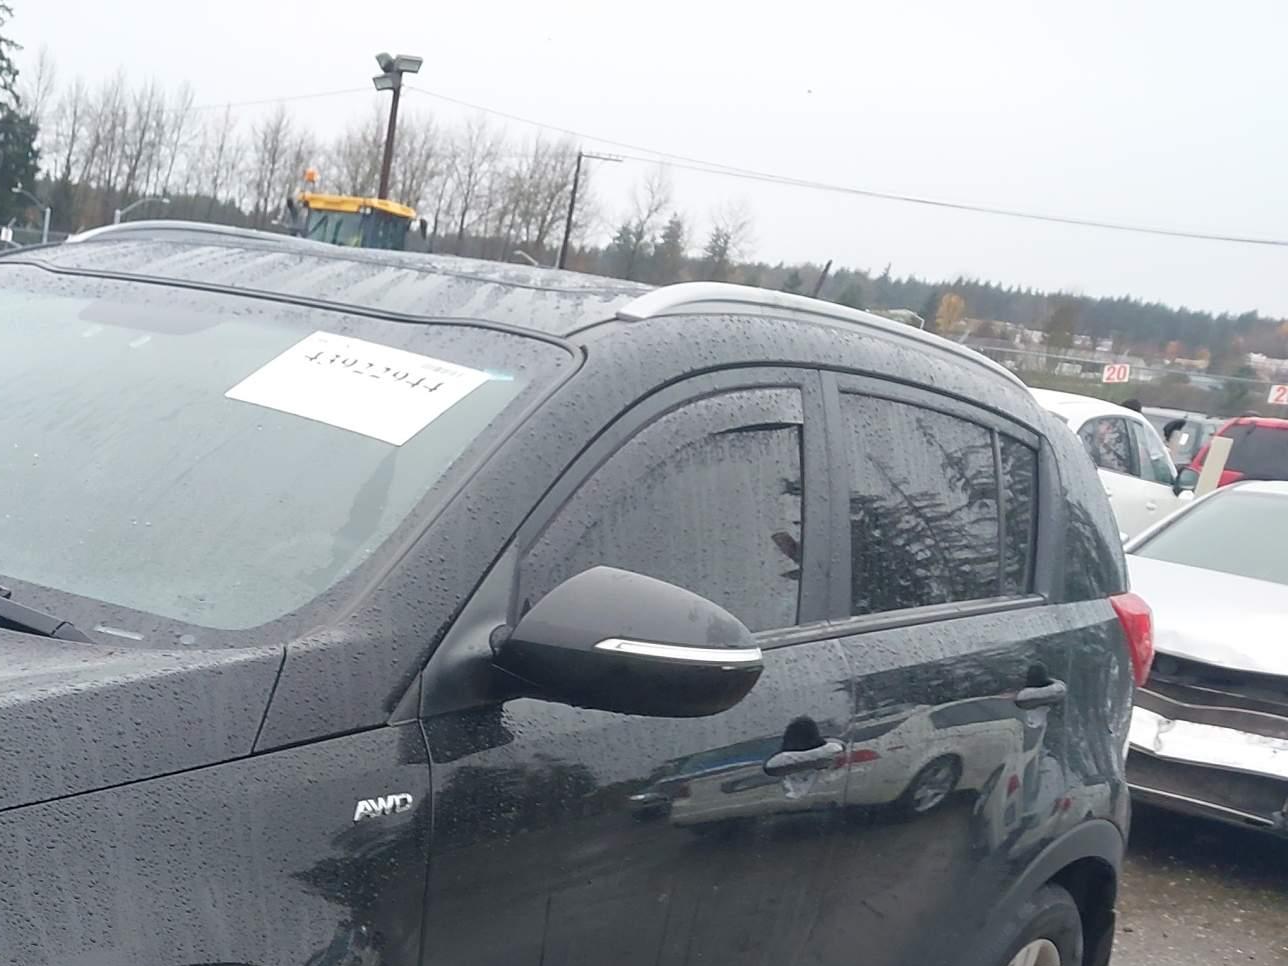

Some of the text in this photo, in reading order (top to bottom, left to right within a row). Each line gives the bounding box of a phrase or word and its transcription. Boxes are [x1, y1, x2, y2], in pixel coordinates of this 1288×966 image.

[1105, 365, 1128, 381] 20
[1274, 386, 1288, 402] 2
[353, 793, 413, 821] AWD
